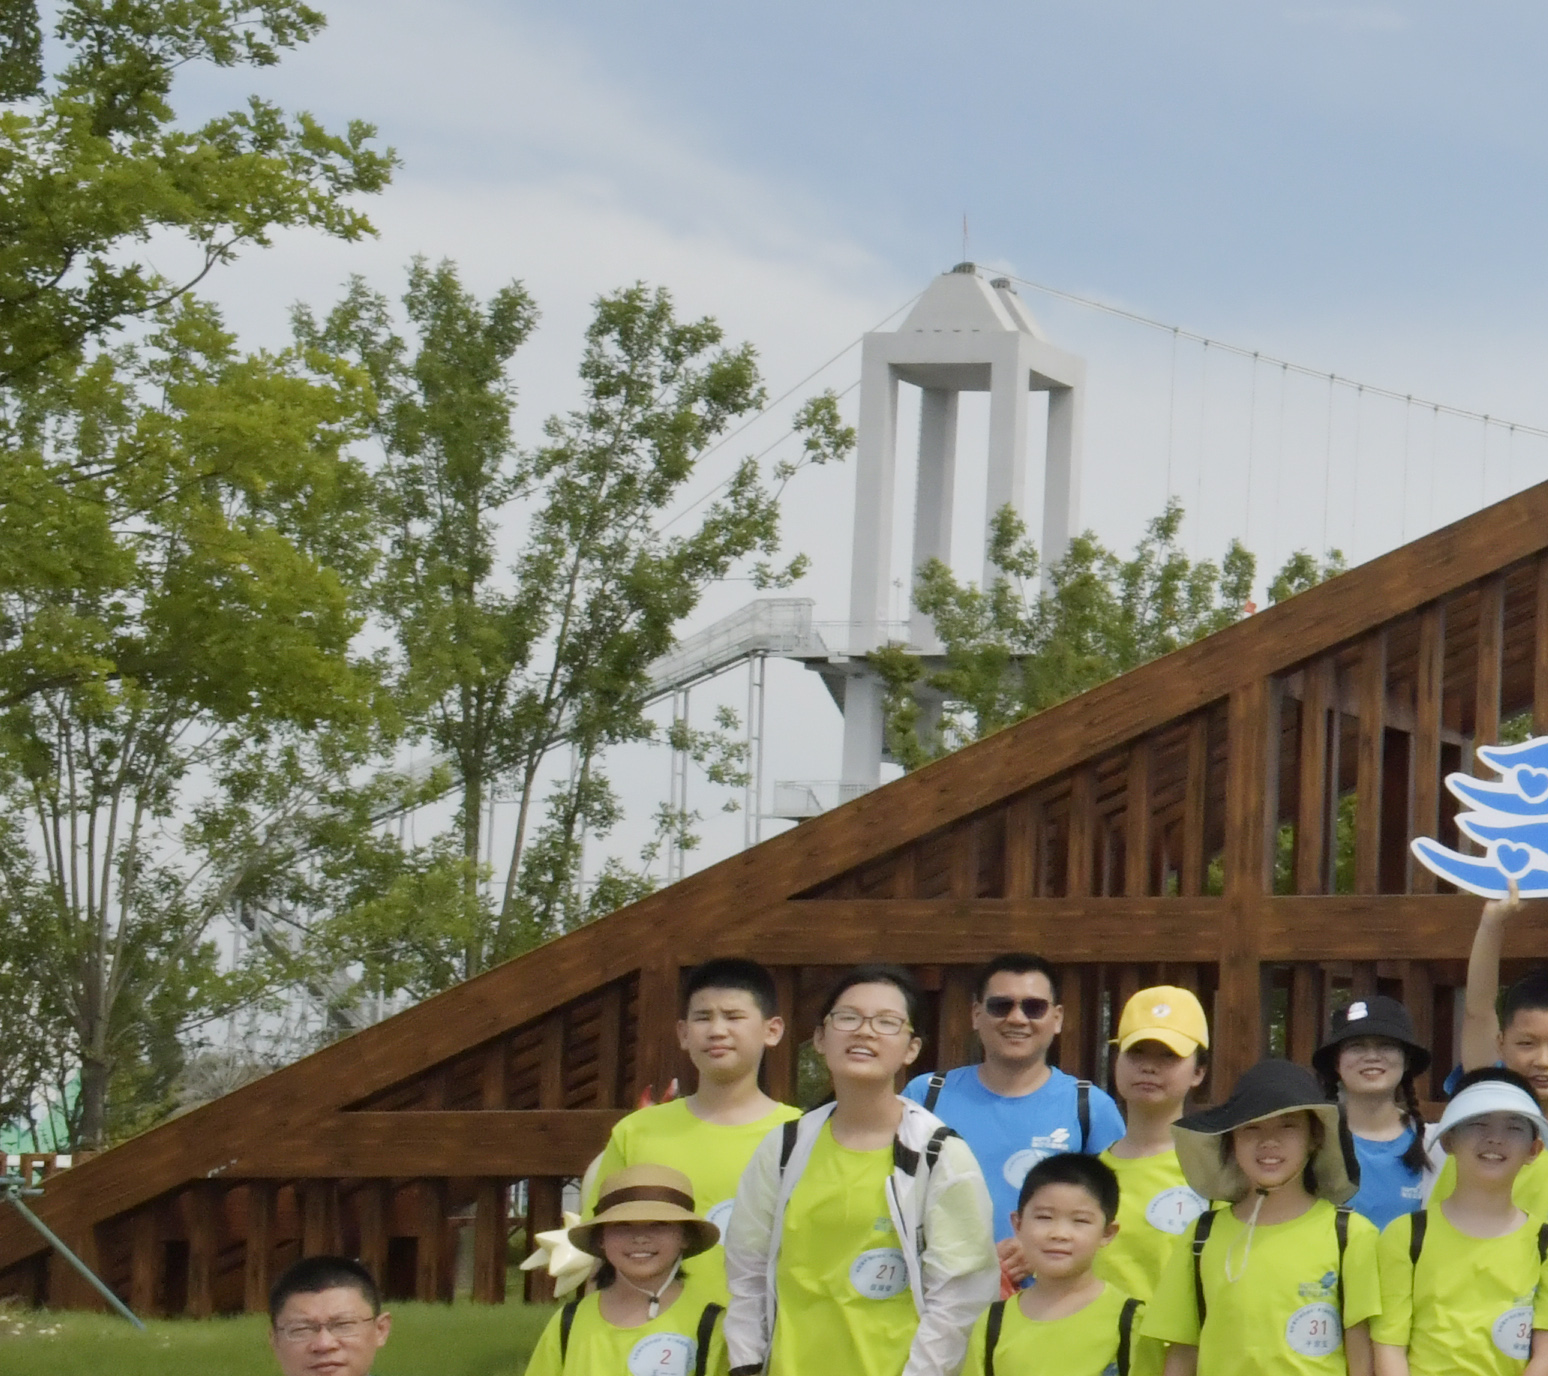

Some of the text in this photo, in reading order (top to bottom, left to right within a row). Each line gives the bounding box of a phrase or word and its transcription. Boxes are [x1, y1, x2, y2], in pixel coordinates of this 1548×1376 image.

[1176, 1202, 1183, 1215] 1
[876, 1265, 896, 1280] 21
[1309, 1320, 1327, 1336] 31
[660, 1349, 672, 1365] 2
